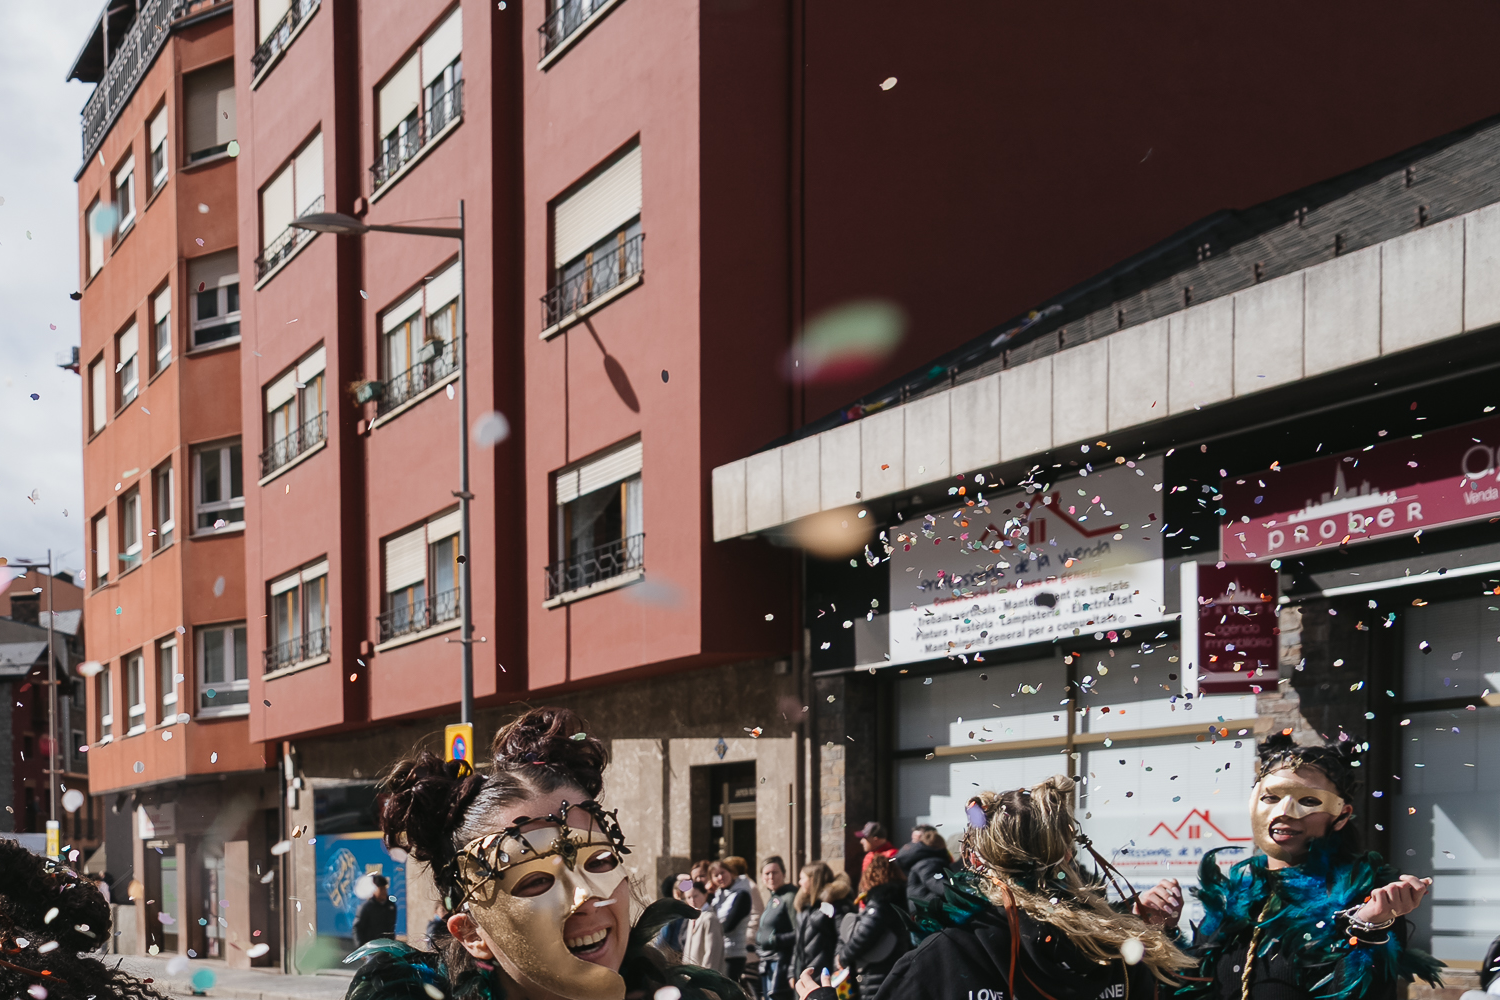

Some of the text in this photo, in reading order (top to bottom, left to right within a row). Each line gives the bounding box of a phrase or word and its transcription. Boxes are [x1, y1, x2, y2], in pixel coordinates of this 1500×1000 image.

[1463, 486, 1499, 506] Venda
[1004, 591, 1071, 610] Manteent
[1074, 588, 1087, 598] de
[916, 629, 948, 641] Pintura
[1072, 594, 1132, 614] Elctricitat
[925, 637, 986, 653] Mantniment
